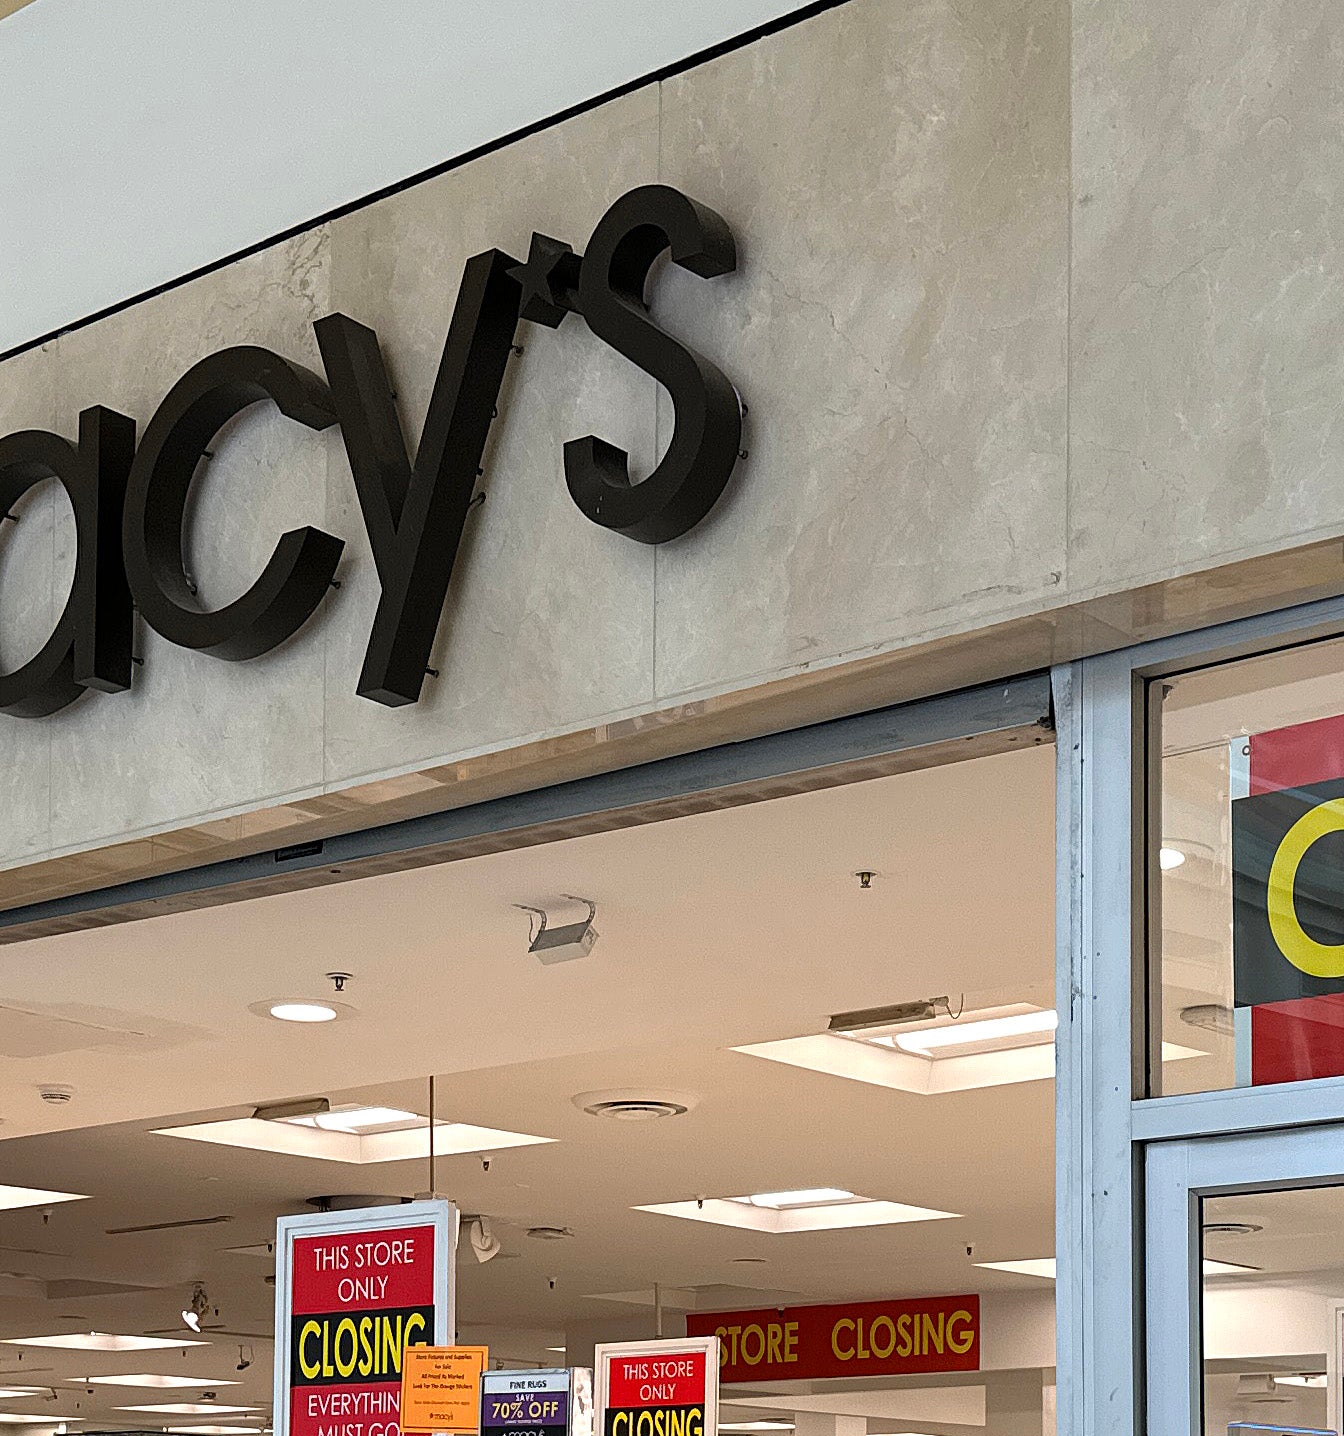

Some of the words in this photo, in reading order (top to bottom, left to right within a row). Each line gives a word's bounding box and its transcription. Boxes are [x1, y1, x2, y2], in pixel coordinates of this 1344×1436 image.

[314, 1245, 349, 1271] THIS
[355, 1239, 414, 1268] STORE
[338, 1275, 389, 1302] ONLY
[299, 1312, 427, 1379] CLOSING
[714, 1321, 800, 1366] STORE
[831, 1309, 975, 1362] CLOSING
[623, 1363, 648, 1380] THIS
[652, 1361, 694, 1378] STORE
[509, 1381, 525, 1389] FINE
[527, 1380, 547, 1389] RUGS
[640, 1384, 676, 1401] ONLY
[308, 1391, 400, 1417] EVERYTHIN
[515, 1394, 534, 1402] SAVE
[492, 1402, 523, 1419] 70%
[528, 1401, 559, 1418] OFF
